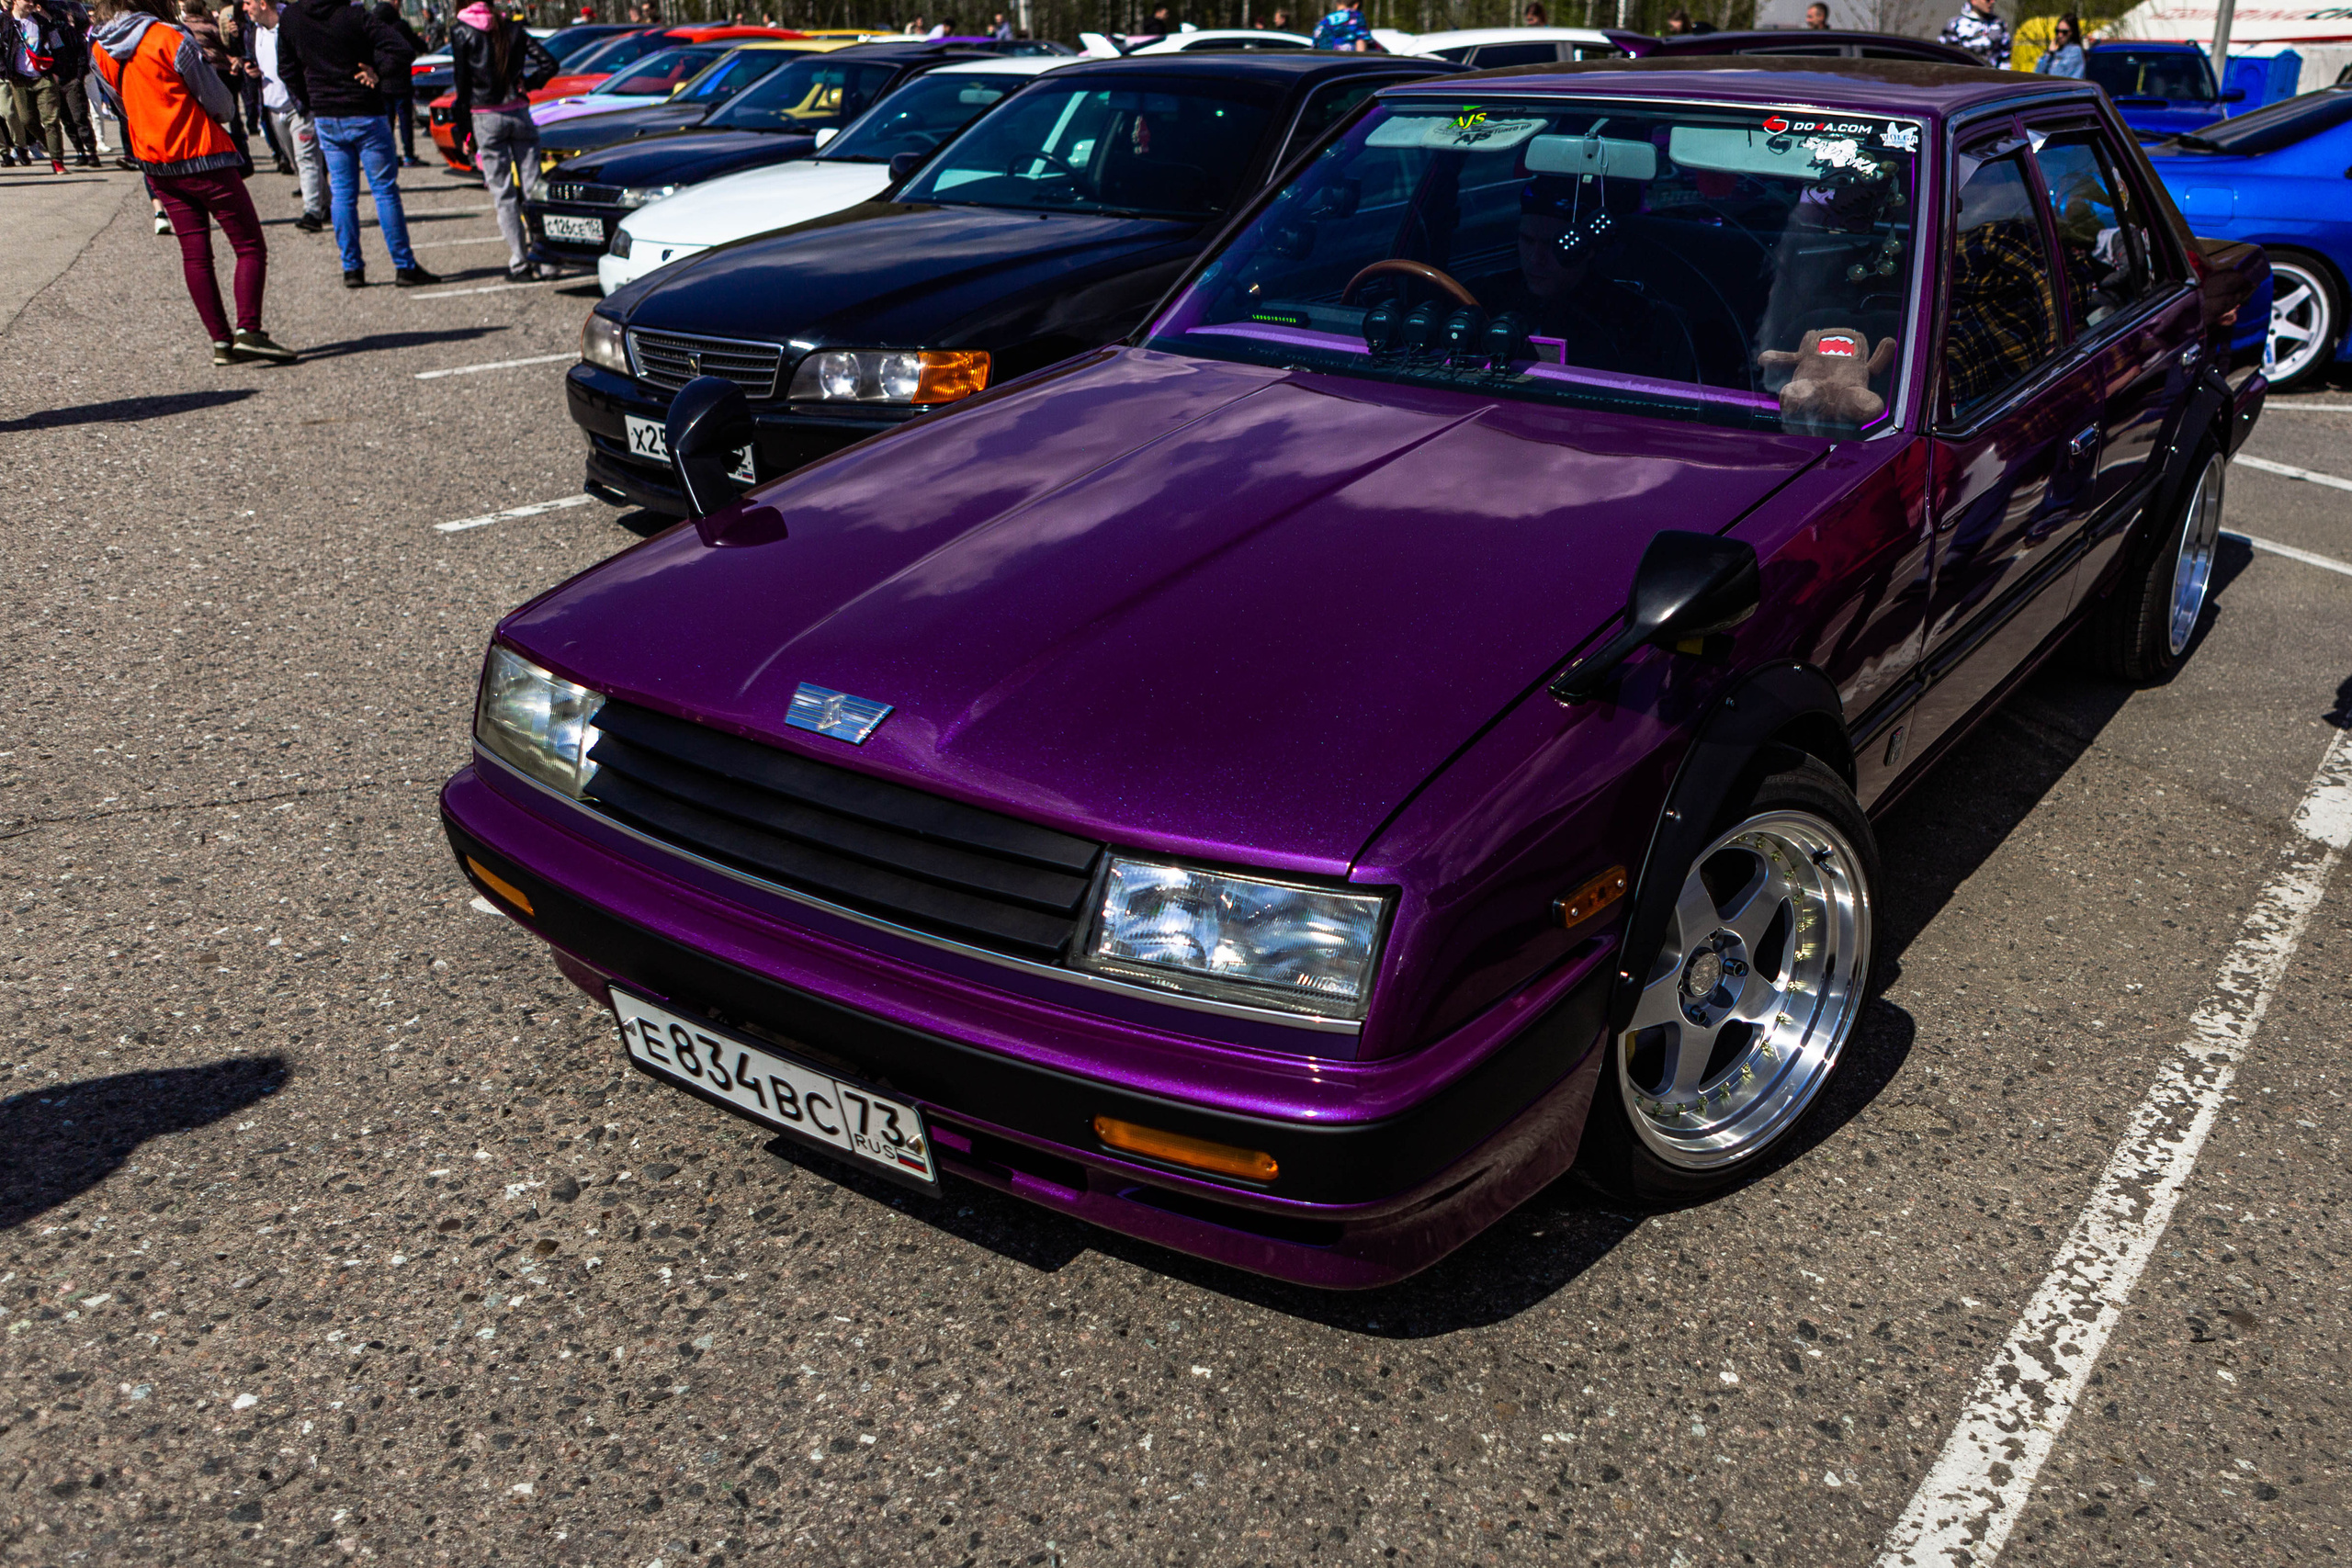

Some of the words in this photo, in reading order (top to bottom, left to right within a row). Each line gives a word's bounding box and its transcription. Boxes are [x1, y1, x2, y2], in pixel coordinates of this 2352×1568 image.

[1448, 112, 1487, 130] AJS
[1792, 121, 1872, 134] DO4A.COM
[843, 1090, 906, 1147] 73
[854, 1133, 897, 1160] RUS
